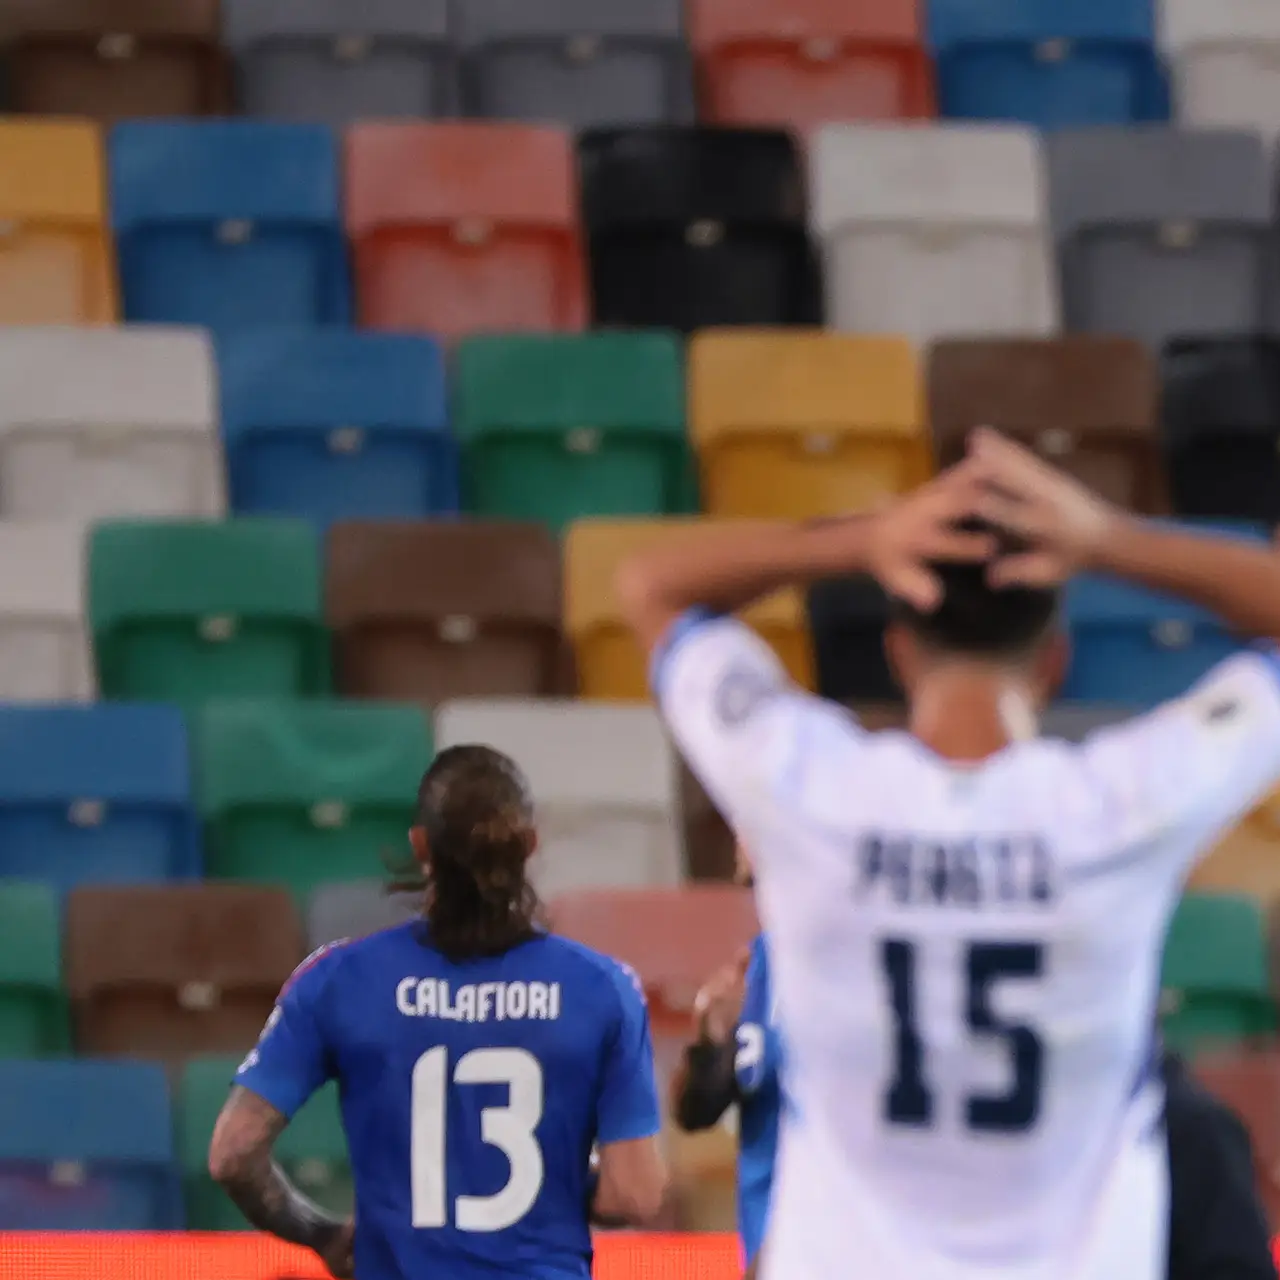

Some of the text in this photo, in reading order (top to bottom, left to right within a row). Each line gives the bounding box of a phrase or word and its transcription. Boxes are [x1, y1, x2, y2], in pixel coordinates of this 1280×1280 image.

[396, 976, 560, 1022] CALAFIORI
[878, 937, 1045, 1130] 15
[411, 1045, 544, 1232] 13
